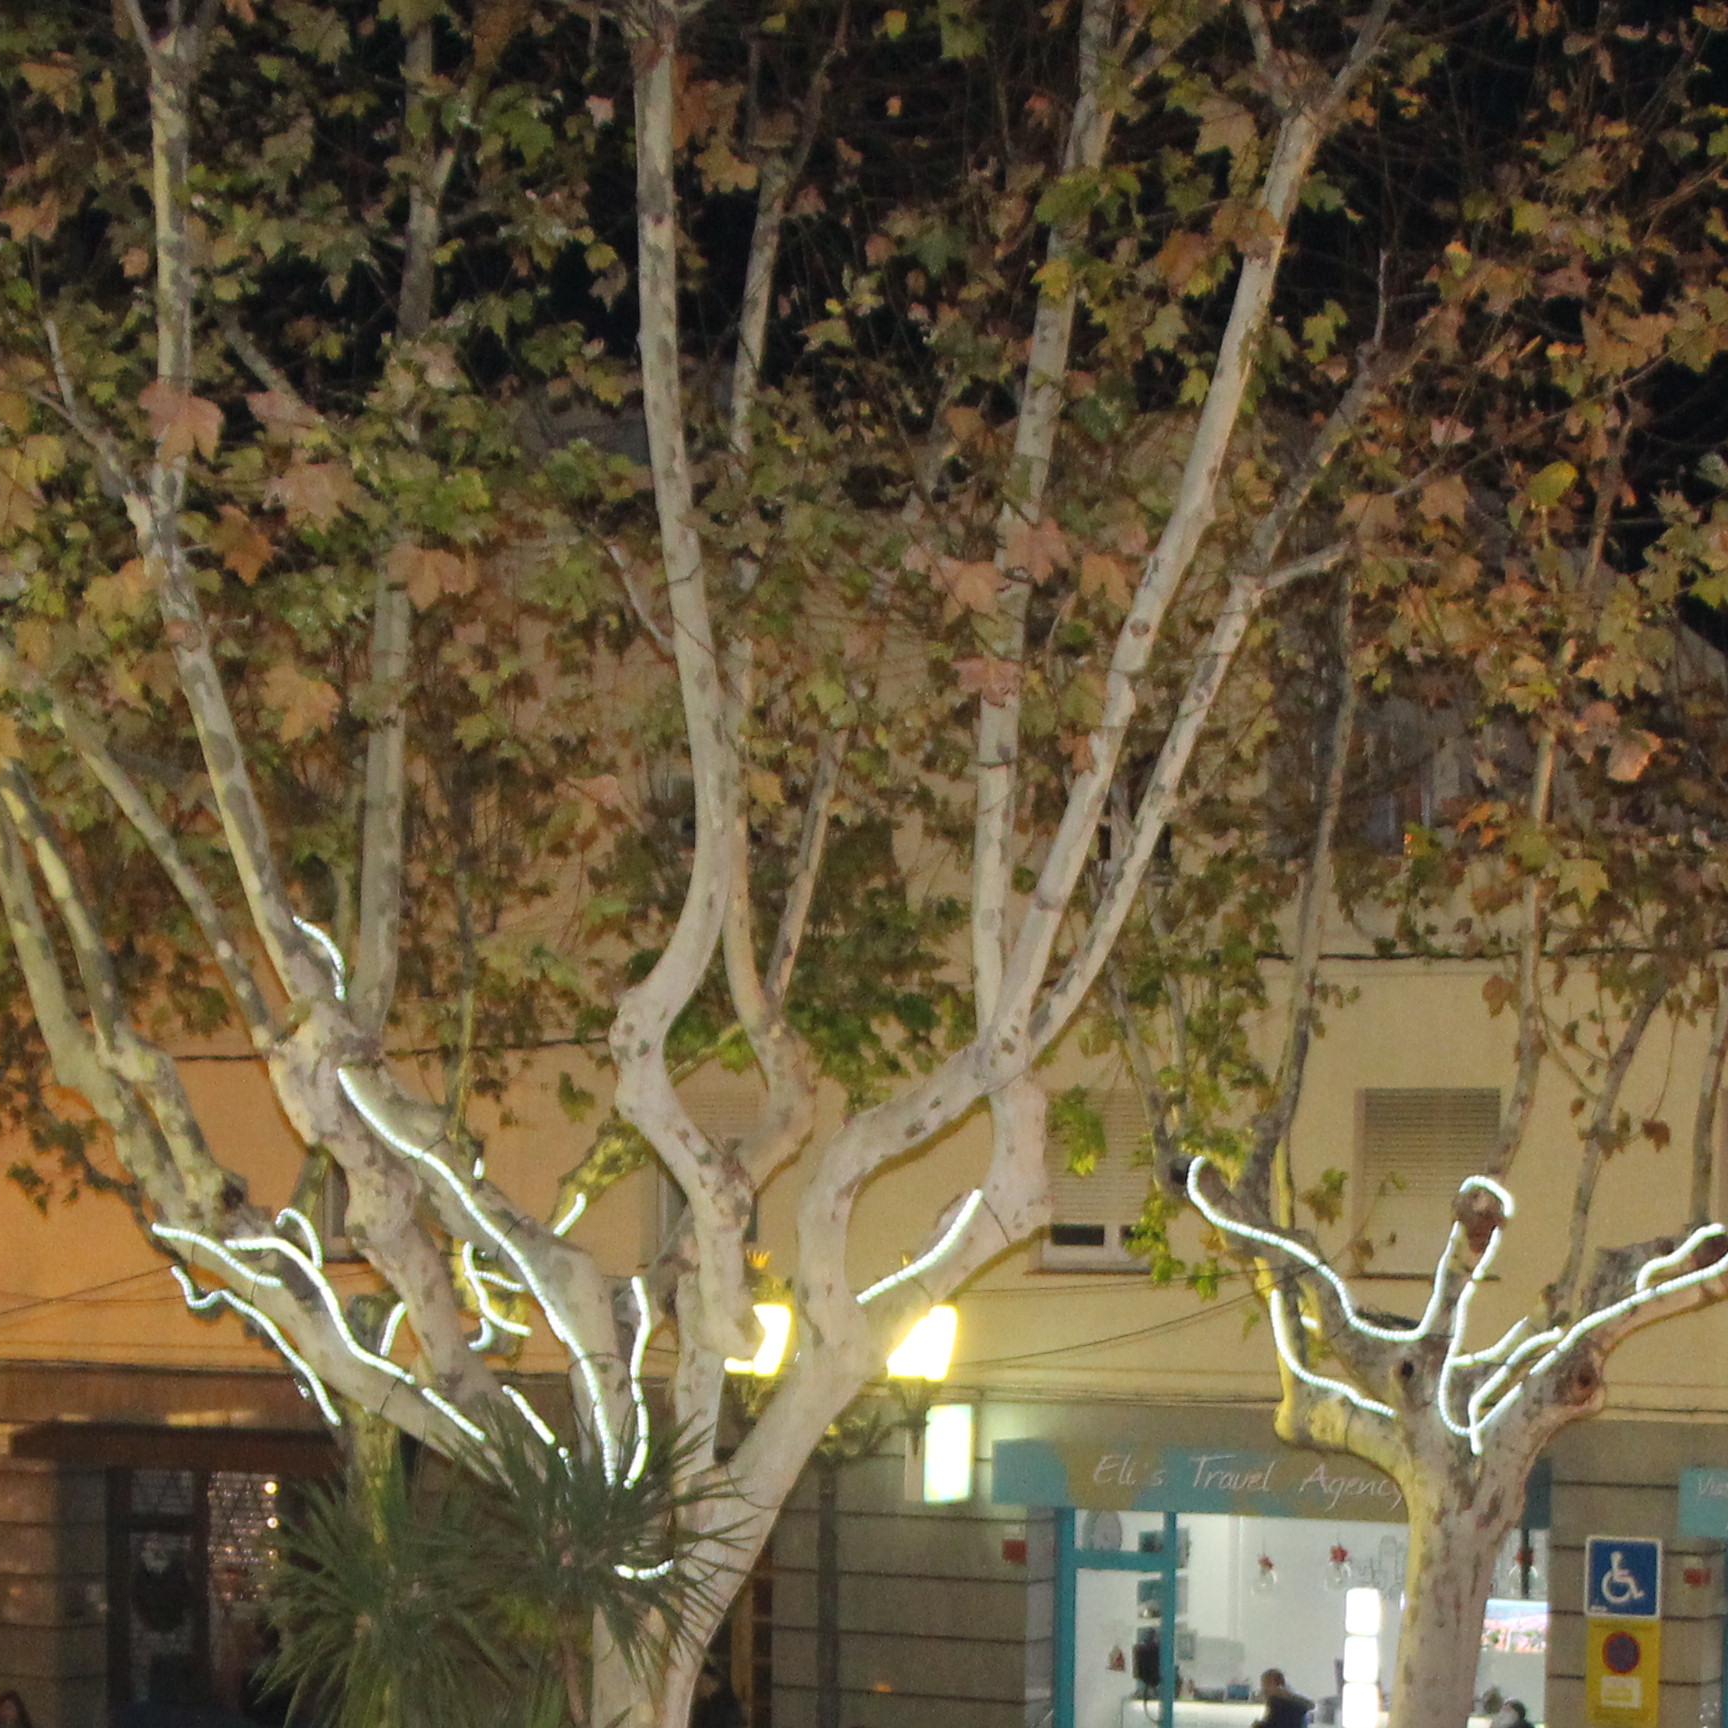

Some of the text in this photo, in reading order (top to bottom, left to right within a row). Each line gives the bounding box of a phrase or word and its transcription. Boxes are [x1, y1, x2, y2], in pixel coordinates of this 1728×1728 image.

[1092, 1451, 1405, 1513] Eli's Travel Agency
